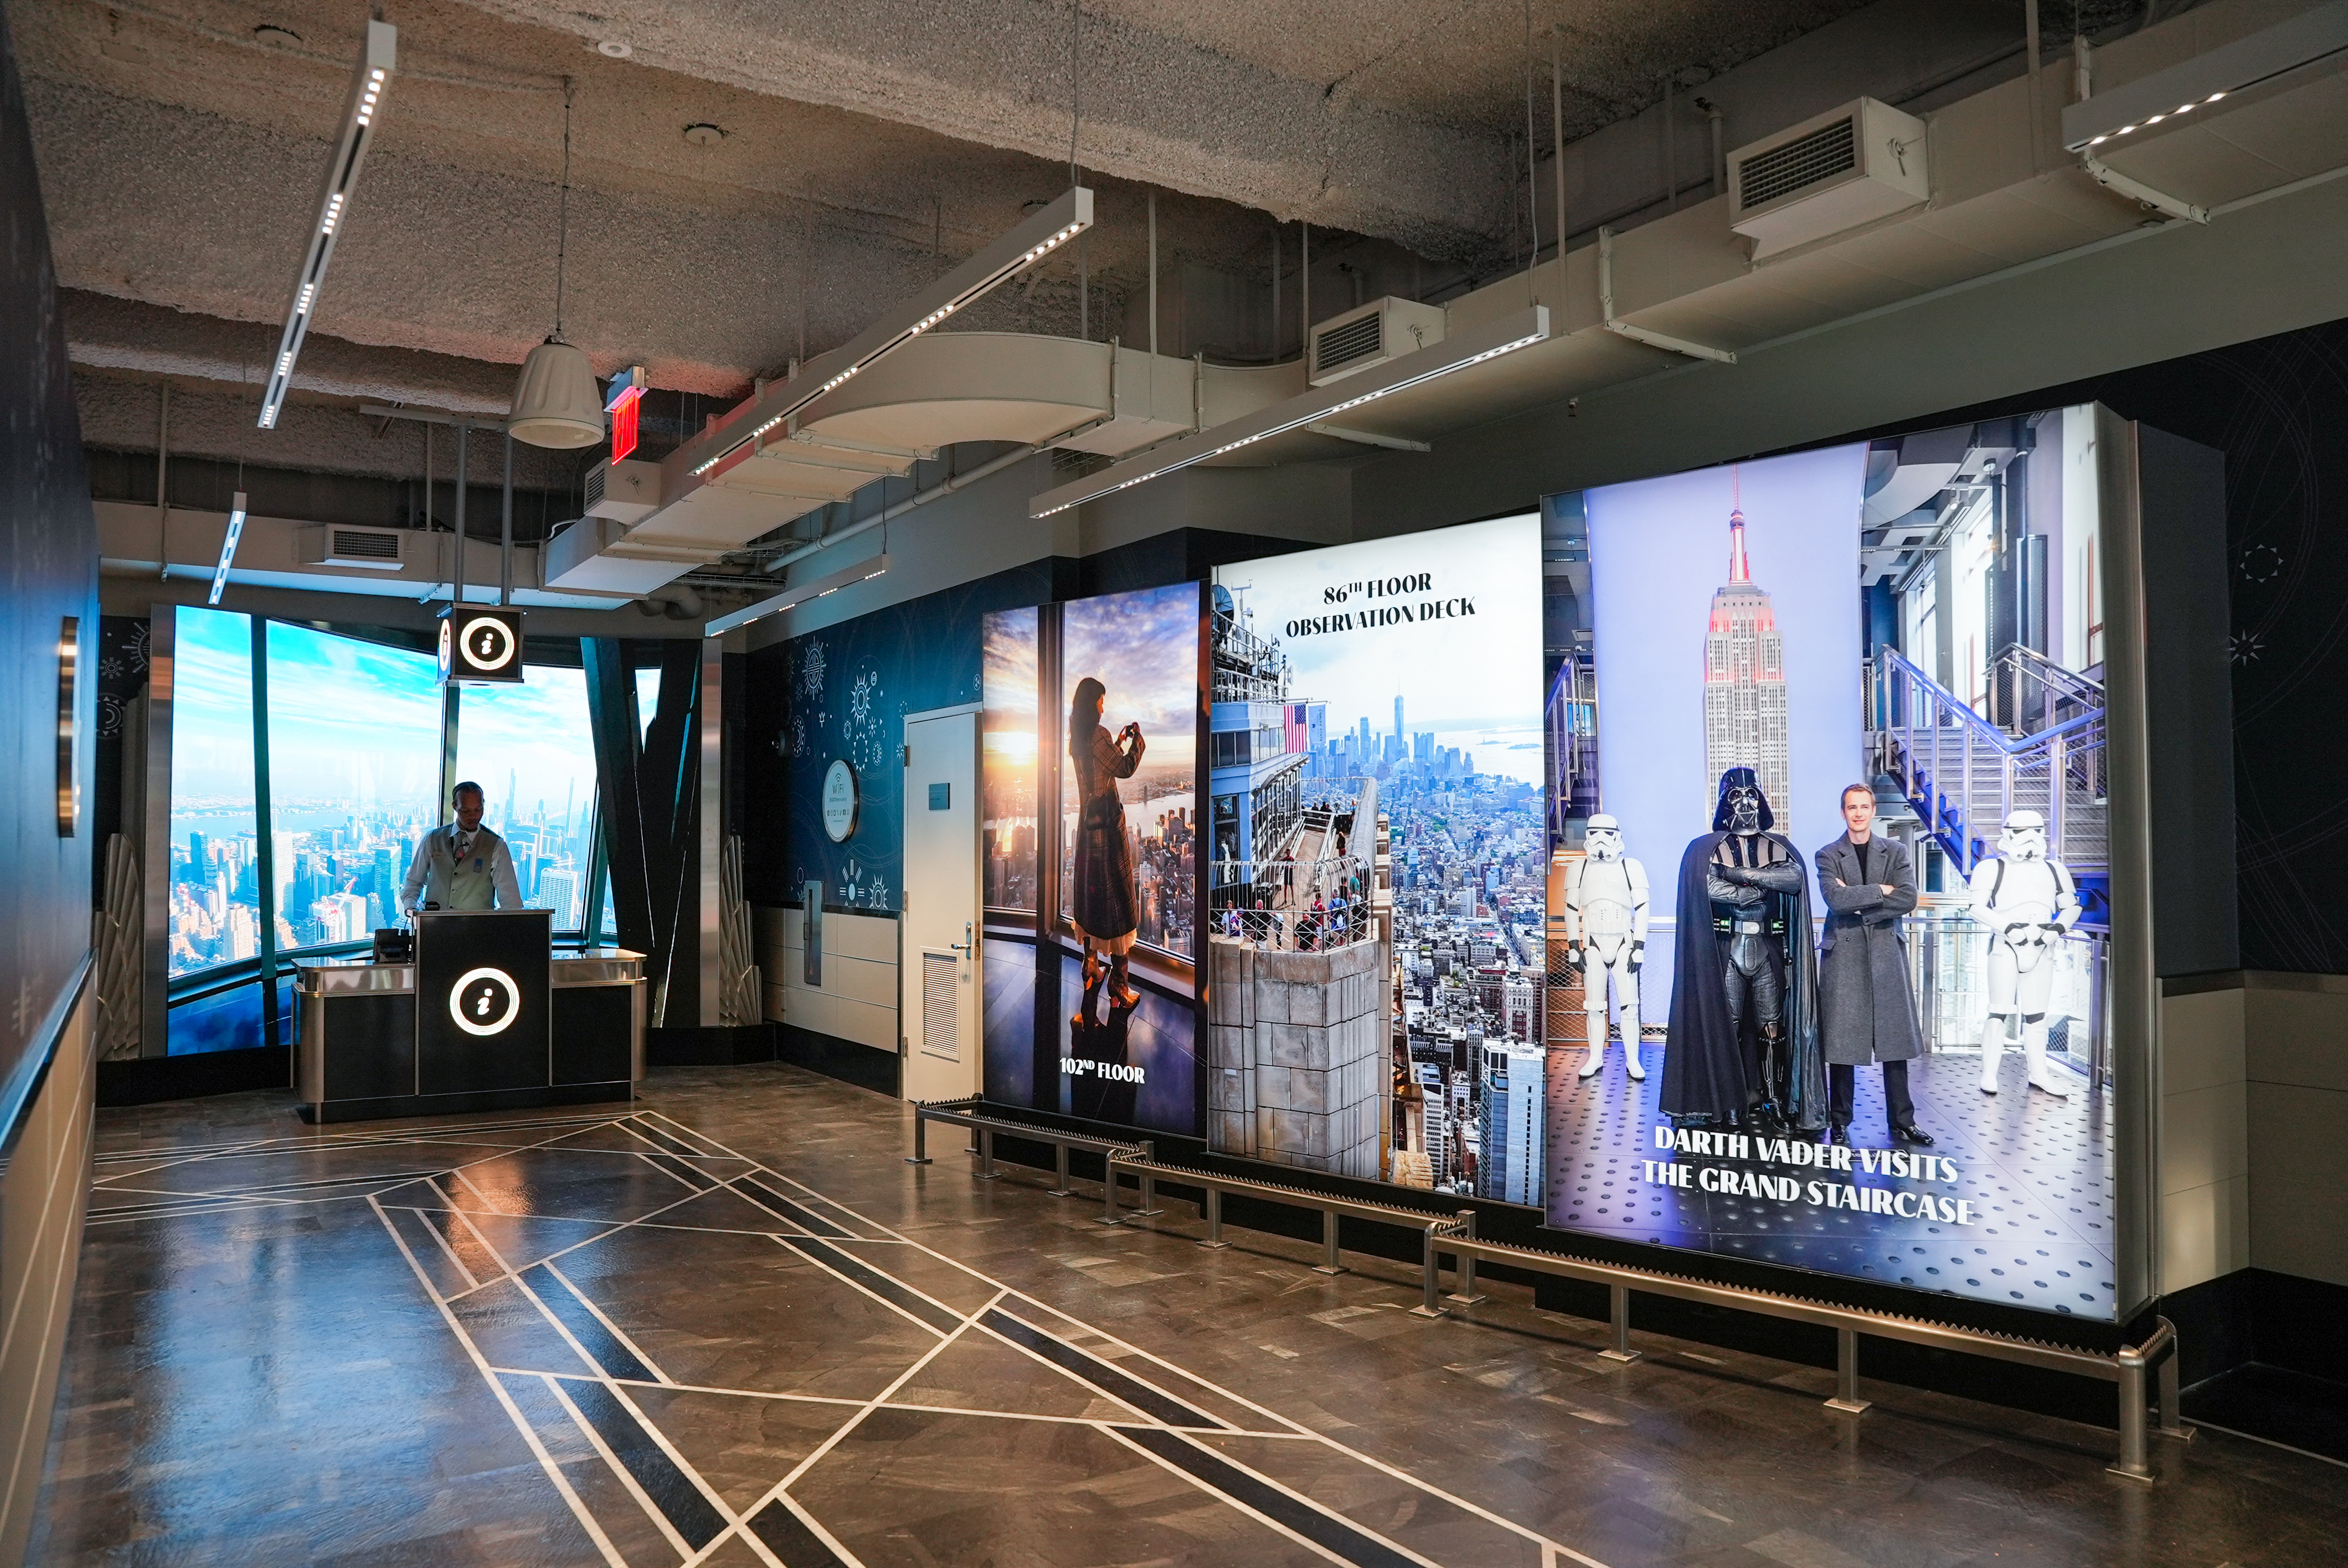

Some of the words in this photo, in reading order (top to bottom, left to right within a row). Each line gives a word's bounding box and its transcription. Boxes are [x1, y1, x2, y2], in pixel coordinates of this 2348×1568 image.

[1324, 581, 1362, 605] 86TH
[1368, 573, 1432, 598] FLOOR
[1286, 605, 1414, 637] OBSERVATION
[1420, 596, 1476, 621] DECK
[832, 783, 844, 794] WiFi
[1059, 1057, 1095, 1075] 102ND
[1098, 1062, 1145, 1084] FLOOR
[1655, 1126, 1749, 1159] DARTH
[1755, 1137, 1853, 1171] VADER
[1859, 1148, 1959, 1183] VISITS
[1641, 1159, 1693, 1189] THE
[1699, 1167, 1800, 1202] GRAND
[1807, 1180, 1975, 1226] STAIRCASE
